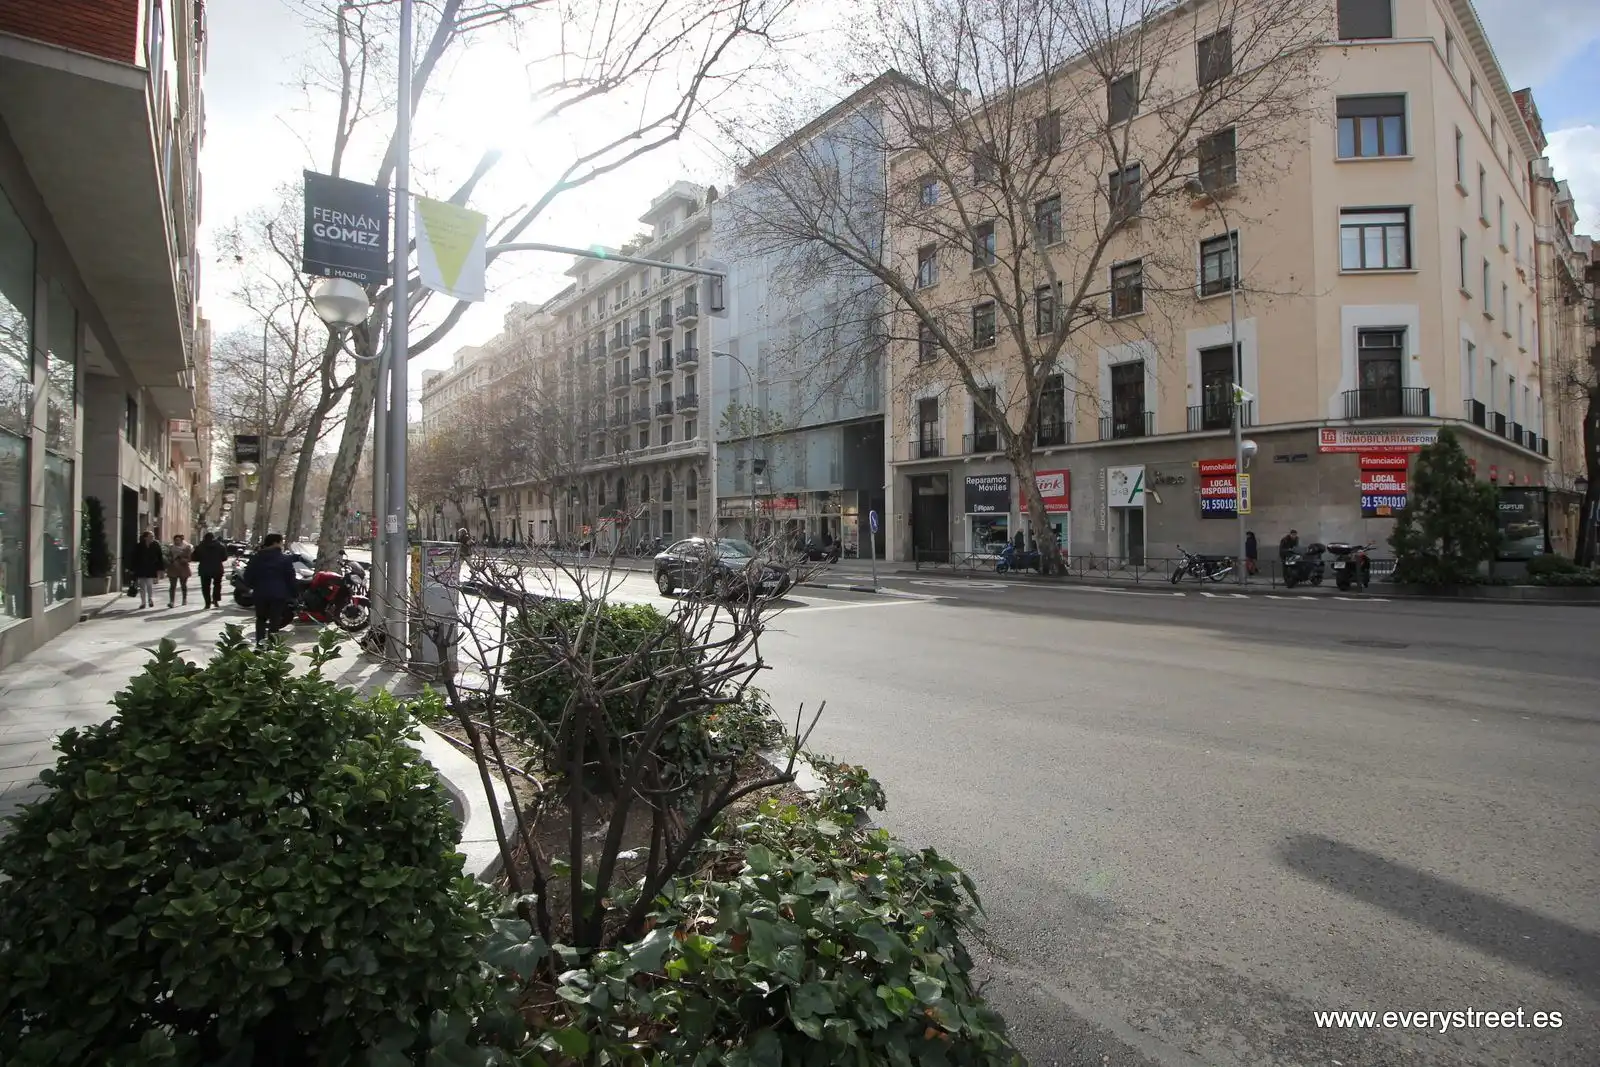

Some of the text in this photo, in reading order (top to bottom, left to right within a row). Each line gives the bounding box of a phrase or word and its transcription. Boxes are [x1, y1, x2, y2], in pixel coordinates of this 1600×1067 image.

[312, 206, 380, 231] FERNÁN
[312, 222, 380, 247] GÓMEZ
[335, 270, 366, 280] MADRID
[1361, 457, 1405, 465] Financiación
[1201, 462, 1237, 471] Inmobiliari
[966, 476, 1007, 486] Reparamos
[978, 484, 1007, 492] Móviles
[1201, 486, 1238, 495] DISPONIBL
[1361, 483, 1406, 491] DISPONIBLE
[1201, 499, 1238, 510] 91 550101
[1361, 496, 1406, 508] 91 5501010
